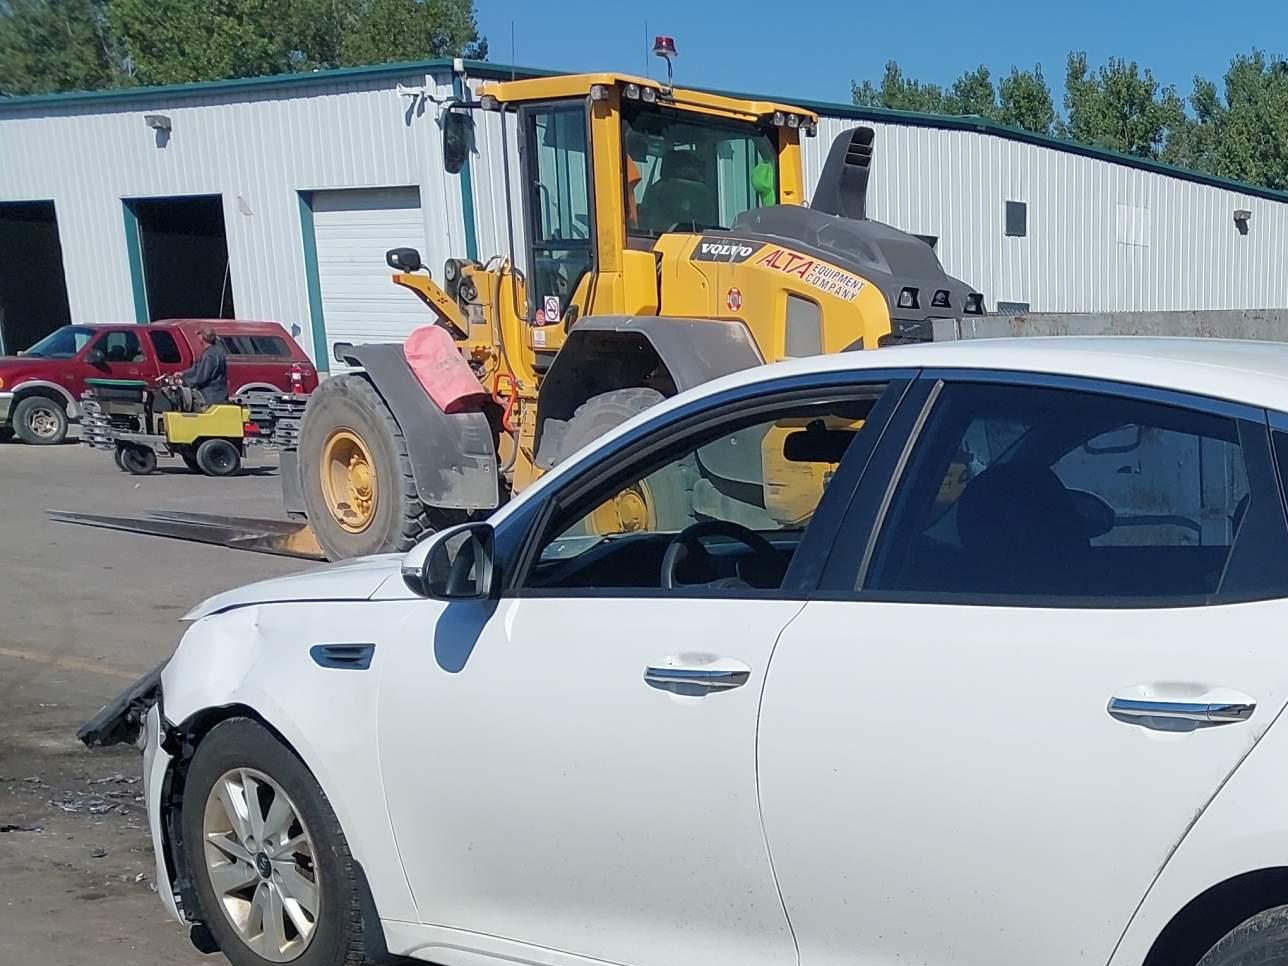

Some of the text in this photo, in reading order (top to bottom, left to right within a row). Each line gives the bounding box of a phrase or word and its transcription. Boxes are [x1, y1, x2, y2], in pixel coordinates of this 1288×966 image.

[701, 243, 752, 257] VOLVO
[755, 249, 815, 279] ALTA
[805, 274, 857, 302] COMPANY
[812, 263, 865, 291] EQUIPMENT
